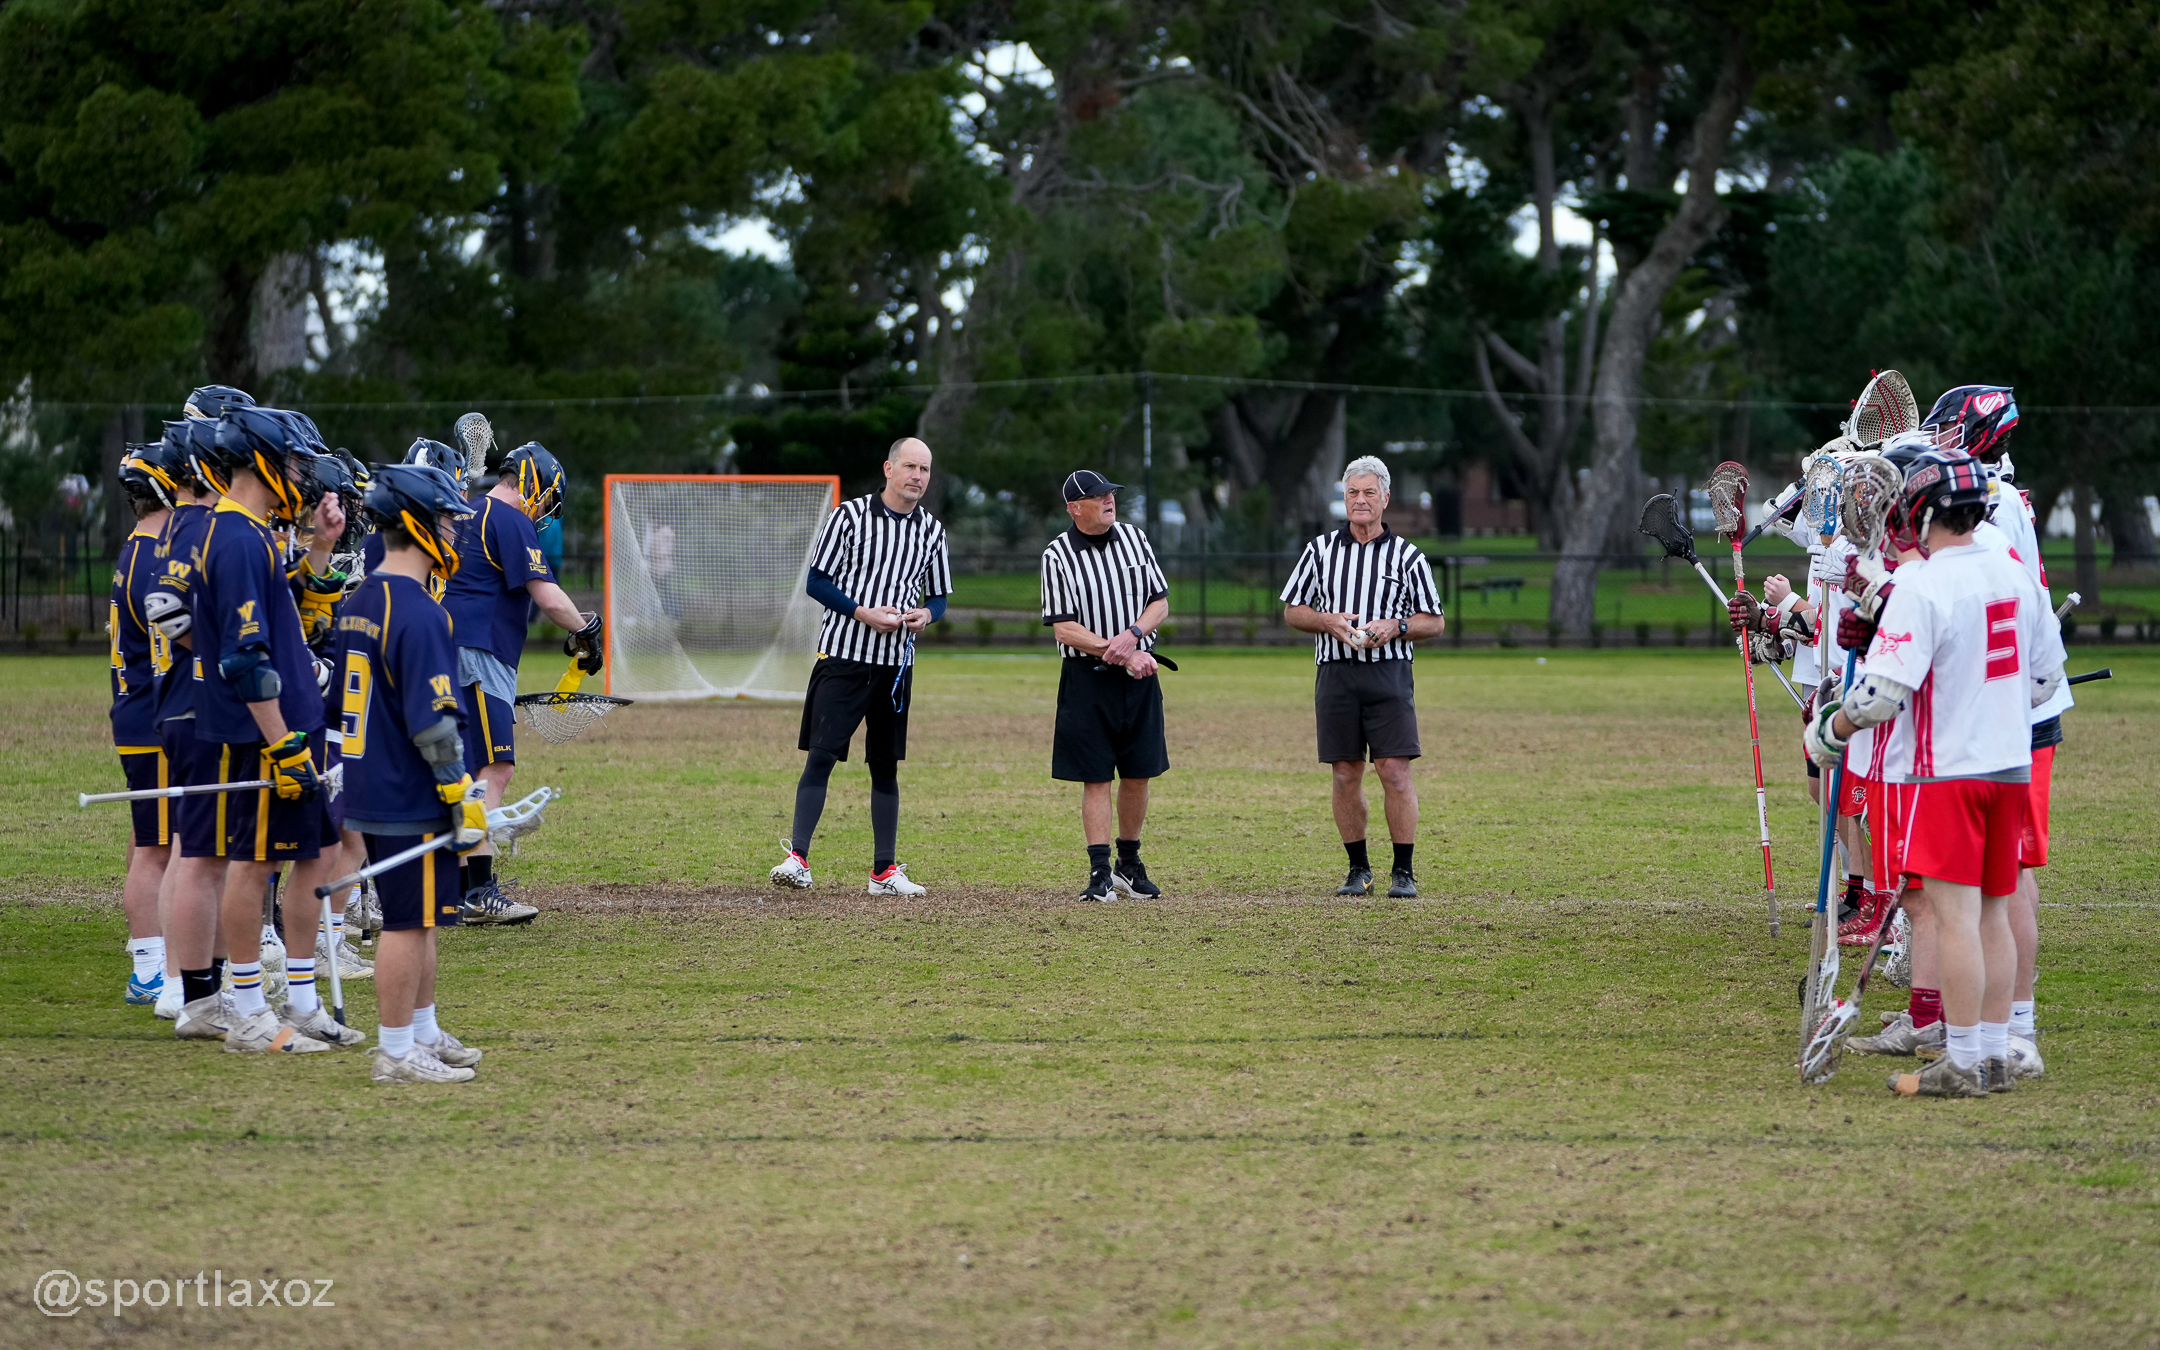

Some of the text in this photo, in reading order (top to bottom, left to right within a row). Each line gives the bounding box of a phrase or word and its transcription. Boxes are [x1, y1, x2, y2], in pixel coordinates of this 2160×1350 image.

[168, 559, 192, 579] W
[1984, 597, 2020, 683] 5
[429, 673, 452, 696] W
[341, 649, 373, 759] 9
[442, 905, 460, 914] BL
